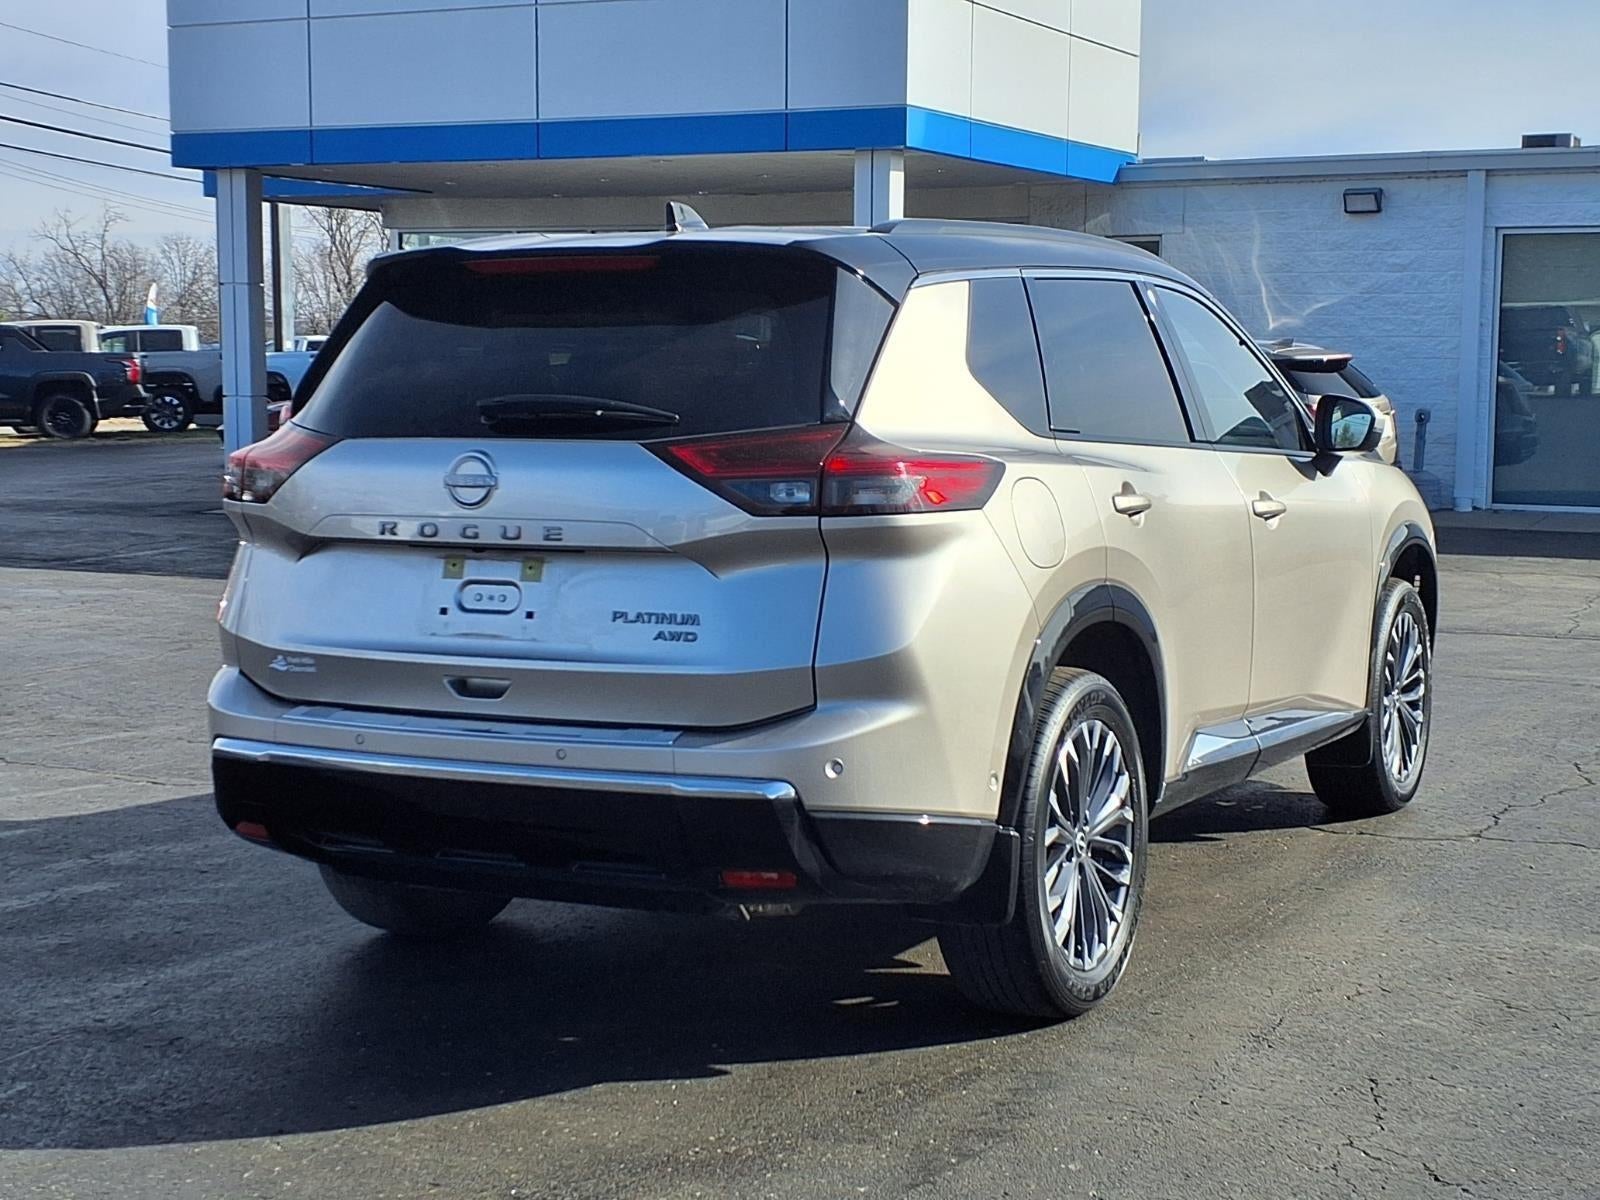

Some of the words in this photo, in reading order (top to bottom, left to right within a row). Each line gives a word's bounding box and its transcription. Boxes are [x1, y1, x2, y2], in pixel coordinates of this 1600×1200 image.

[378, 520, 564, 542] ROGUE
[611, 610, 701, 626] PLATINUM
[652, 630, 698, 643] AWD
